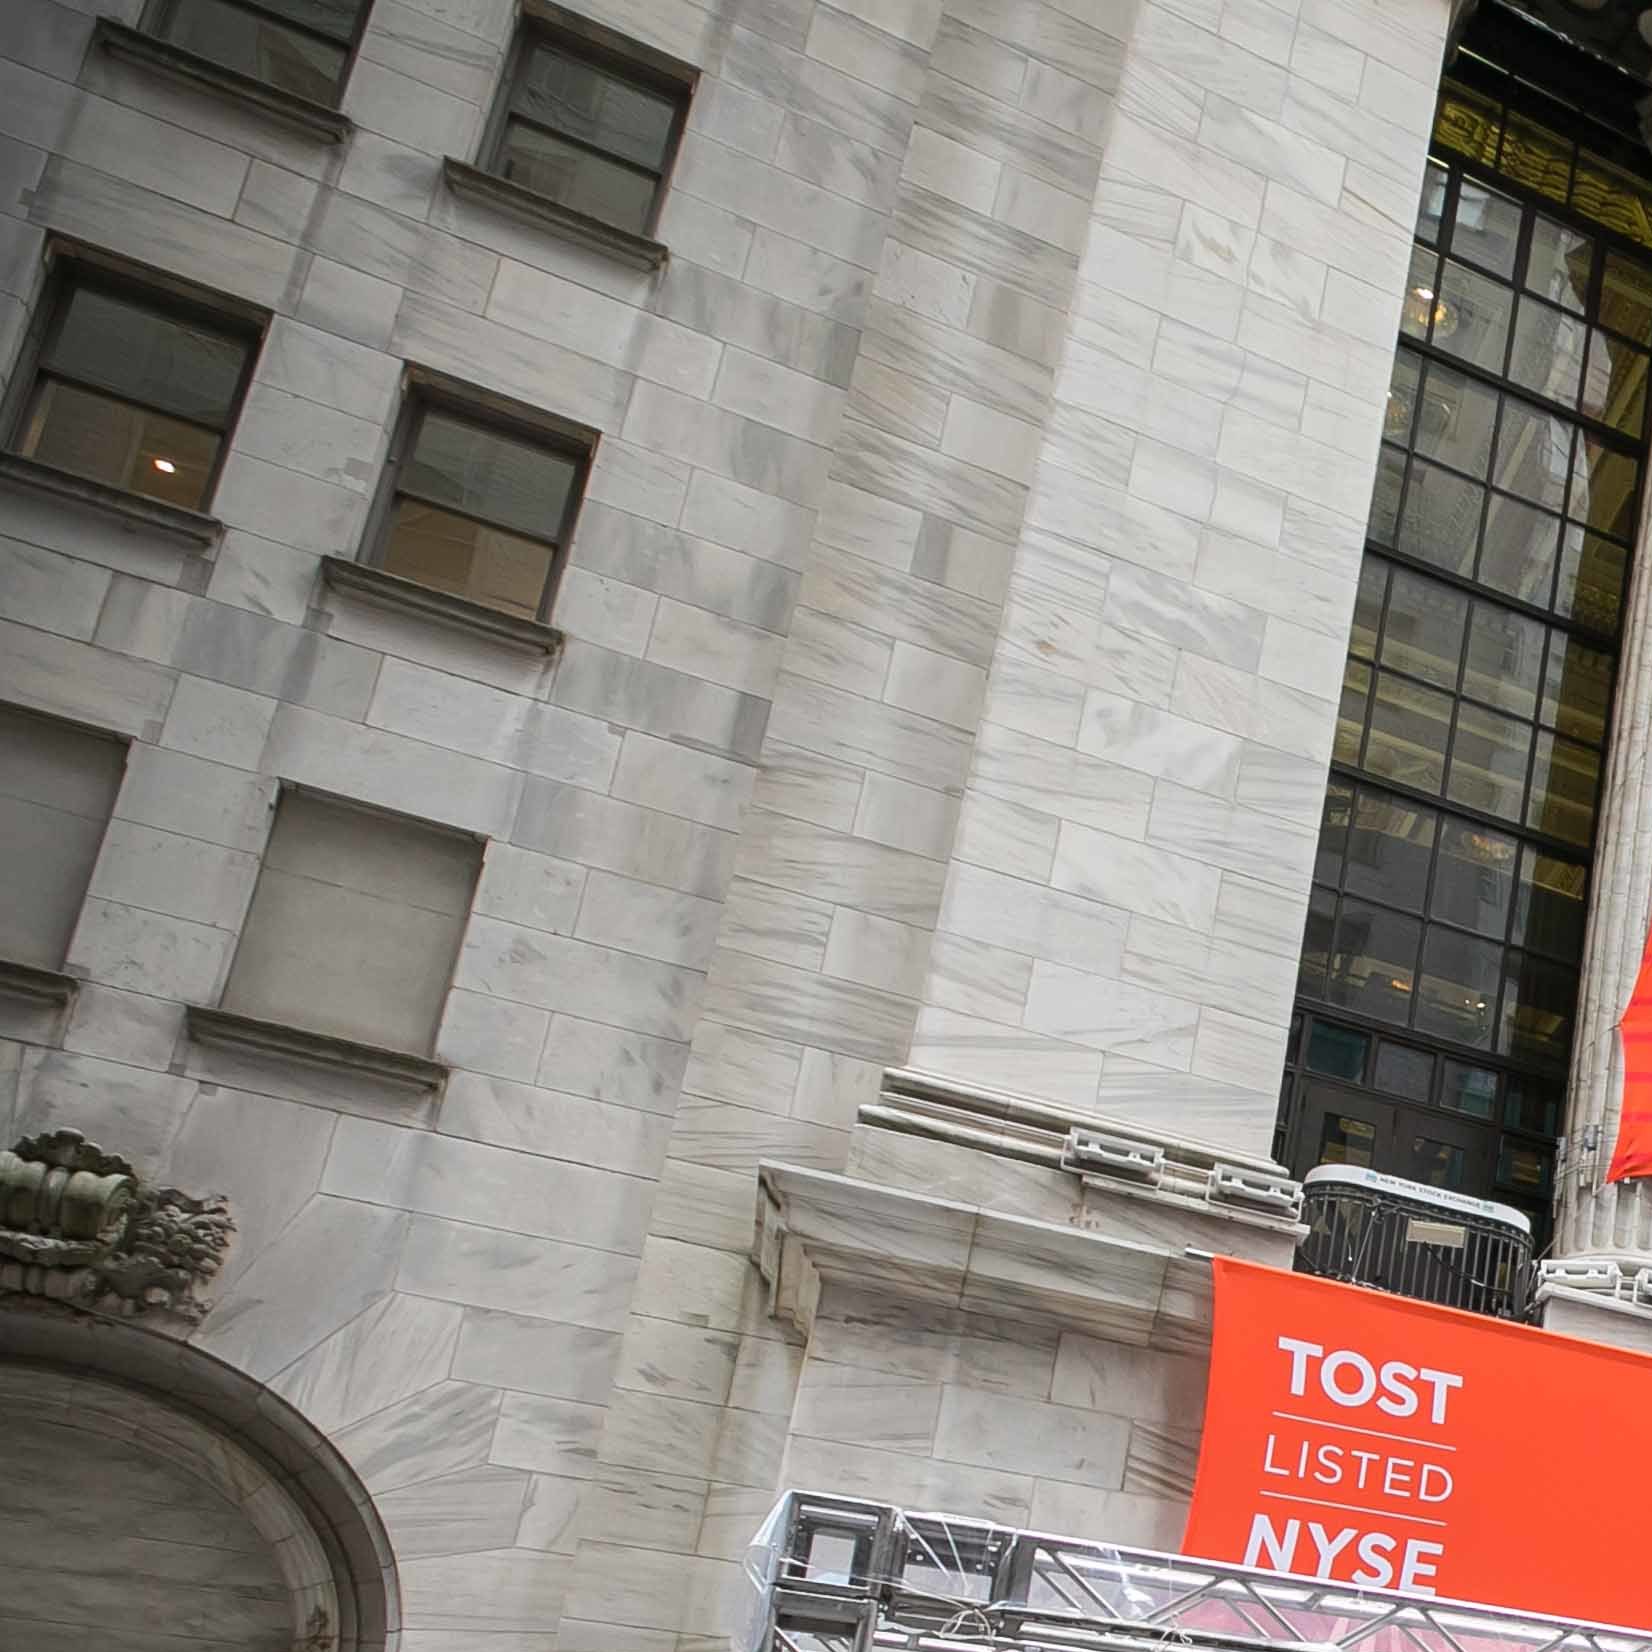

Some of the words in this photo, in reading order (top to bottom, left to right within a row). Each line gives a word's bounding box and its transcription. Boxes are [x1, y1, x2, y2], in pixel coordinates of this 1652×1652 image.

[1278, 1337, 1463, 1425] TOST
[1264, 1435, 1455, 1502] LISTED
[1245, 1513, 1444, 1598] NYSE
